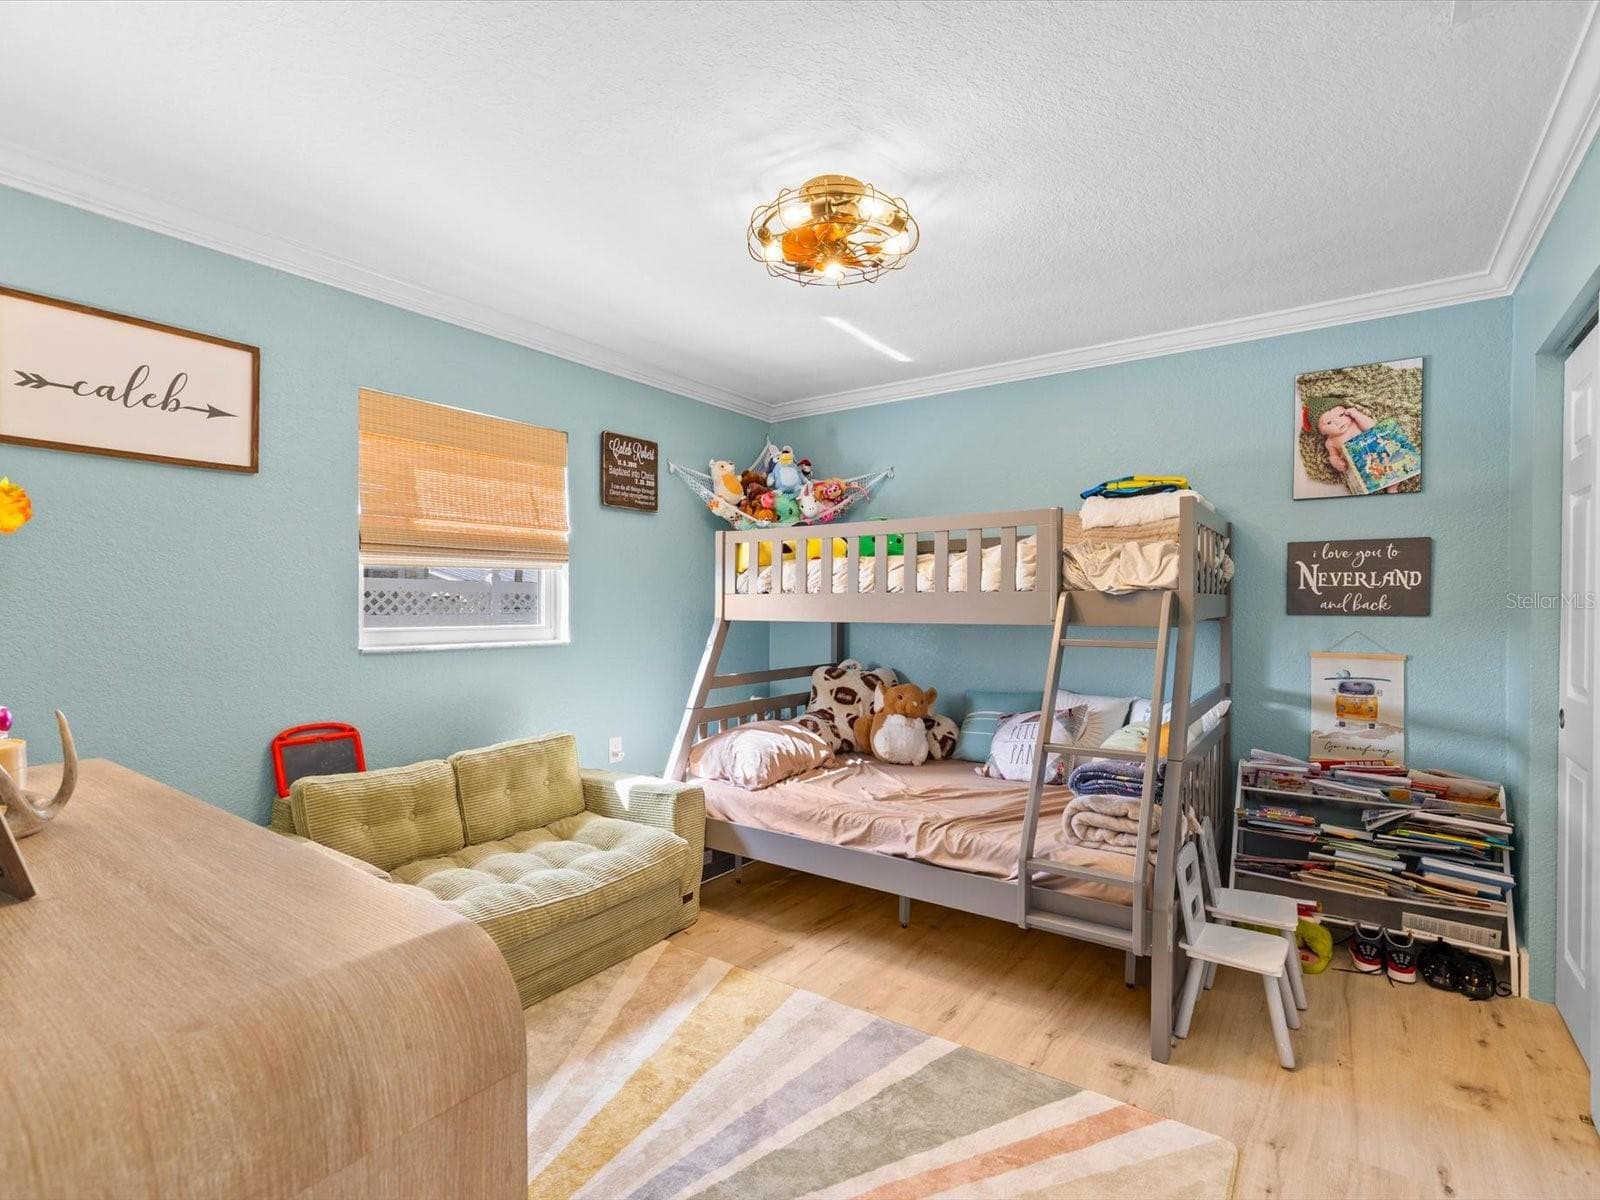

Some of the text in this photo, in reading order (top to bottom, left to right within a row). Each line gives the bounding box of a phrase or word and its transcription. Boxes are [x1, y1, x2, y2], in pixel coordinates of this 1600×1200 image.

[72, 364, 188, 412] caleb
[1322, 543, 1352, 560] love
[1352, 549, 1381, 568] you
[1386, 543, 1400, 559] to
[1320, 593, 1391, 612] and back
[1010, 723, 1037, 740] PETE
